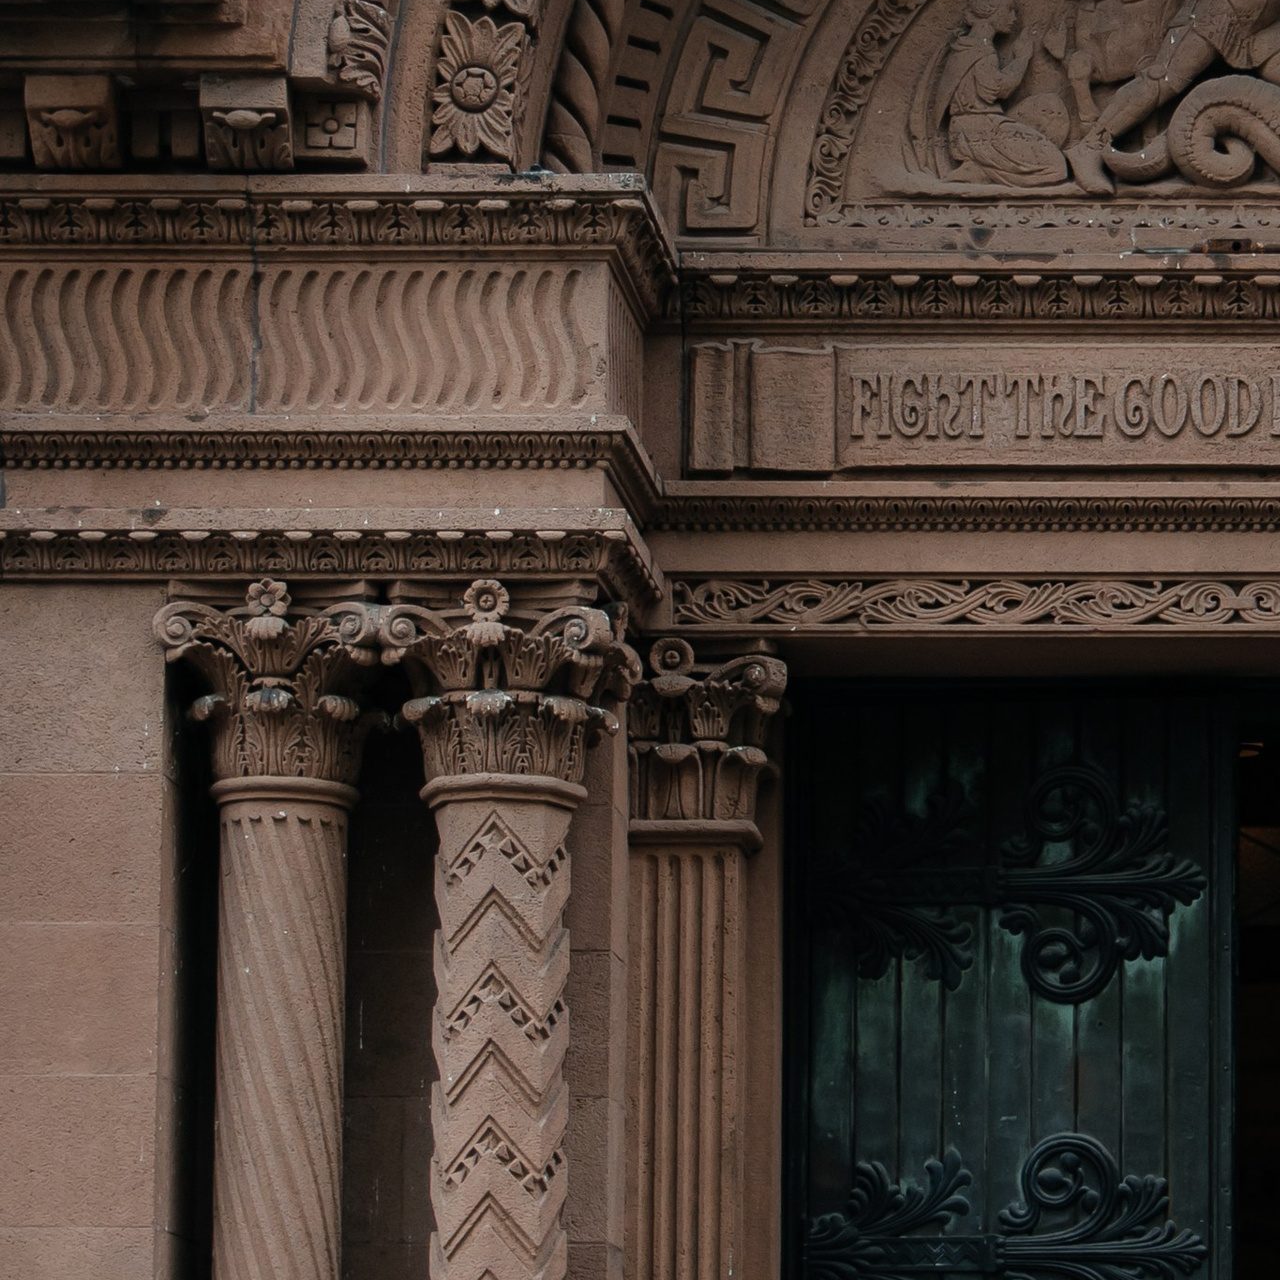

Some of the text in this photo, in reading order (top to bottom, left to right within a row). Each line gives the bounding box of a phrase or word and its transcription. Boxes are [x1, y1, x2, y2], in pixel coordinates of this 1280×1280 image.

[850, 373, 995, 438] FIGHT
[1005, 373, 1105, 438] THE
[1113, 373, 1263, 438] GOOD
